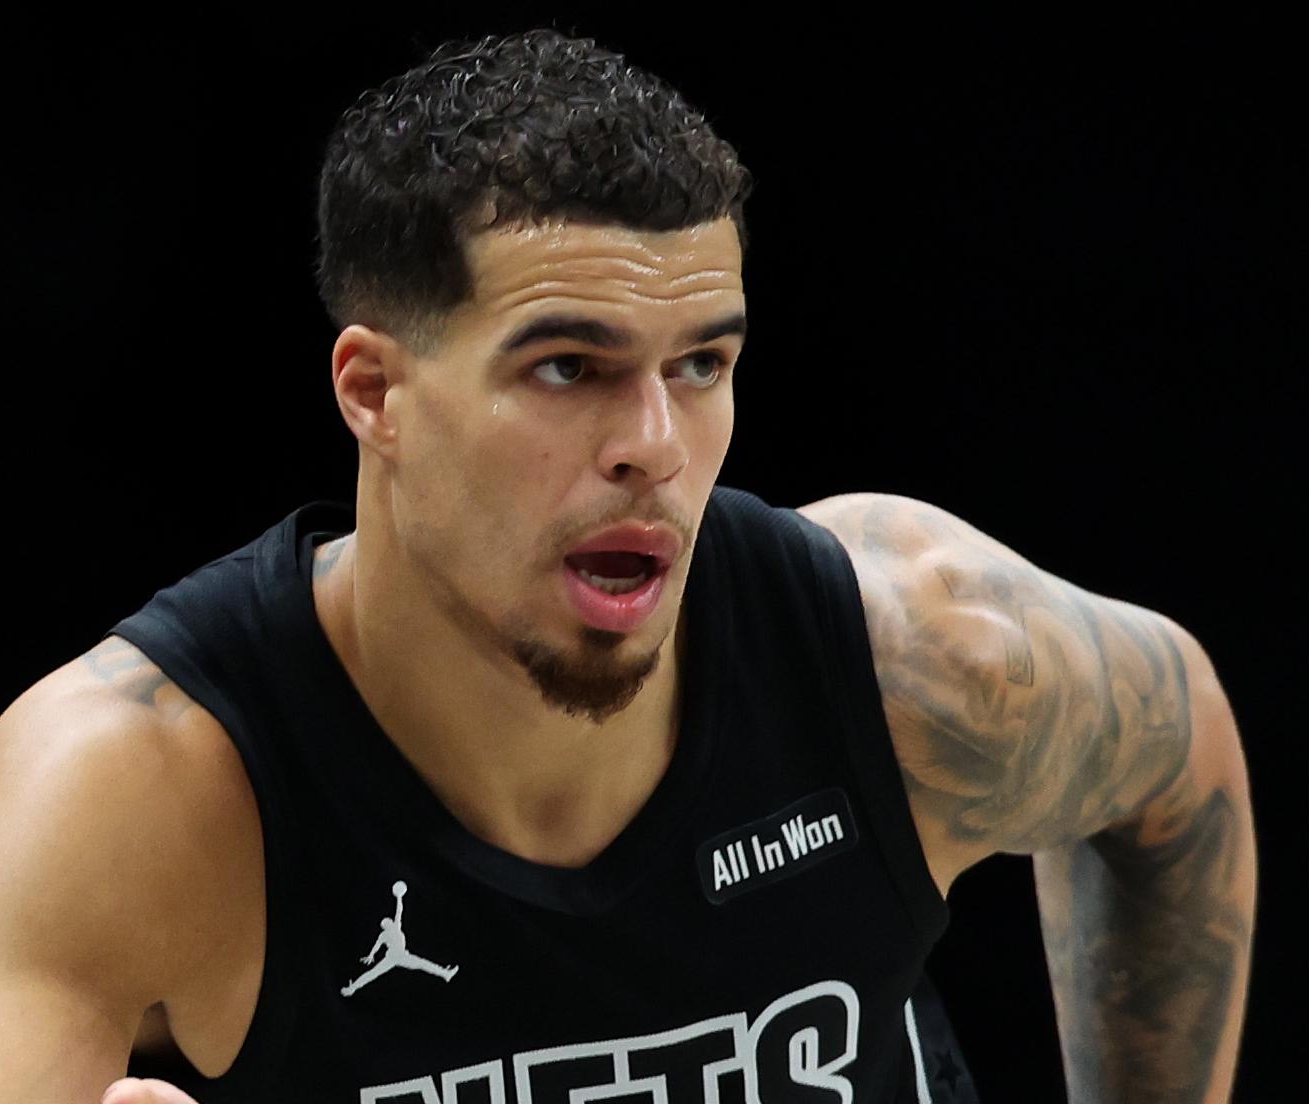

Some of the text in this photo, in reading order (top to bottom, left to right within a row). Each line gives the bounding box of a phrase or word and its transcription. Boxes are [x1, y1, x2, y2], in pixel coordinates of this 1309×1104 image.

[713, 814, 844, 891] All In Won
